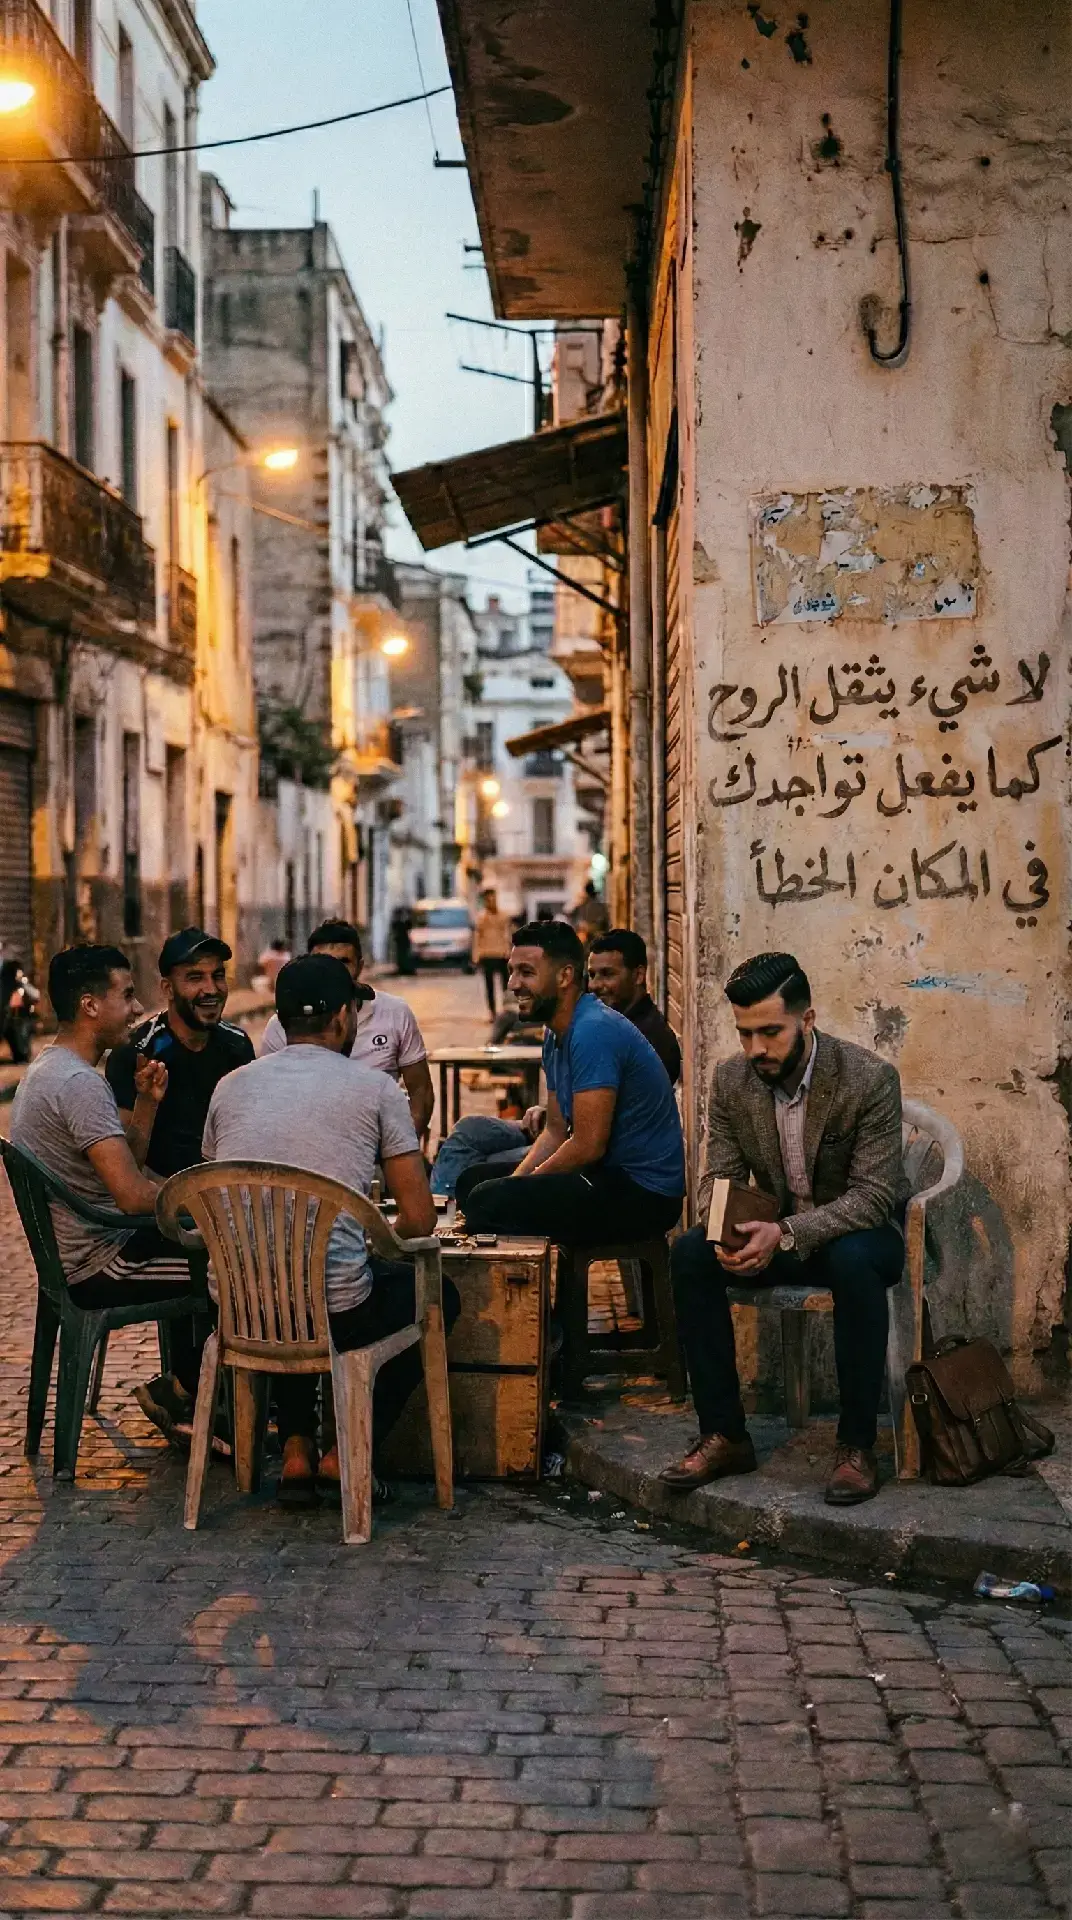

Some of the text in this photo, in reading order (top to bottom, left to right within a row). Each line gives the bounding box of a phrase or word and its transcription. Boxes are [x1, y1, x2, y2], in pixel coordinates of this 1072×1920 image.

[708, 644, 1051, 742] لا شيء يثقل الروح
[708, 735, 1063, 819] كما يفعل تواجدك
[750, 838, 1051, 929] في المكان الخطأ
